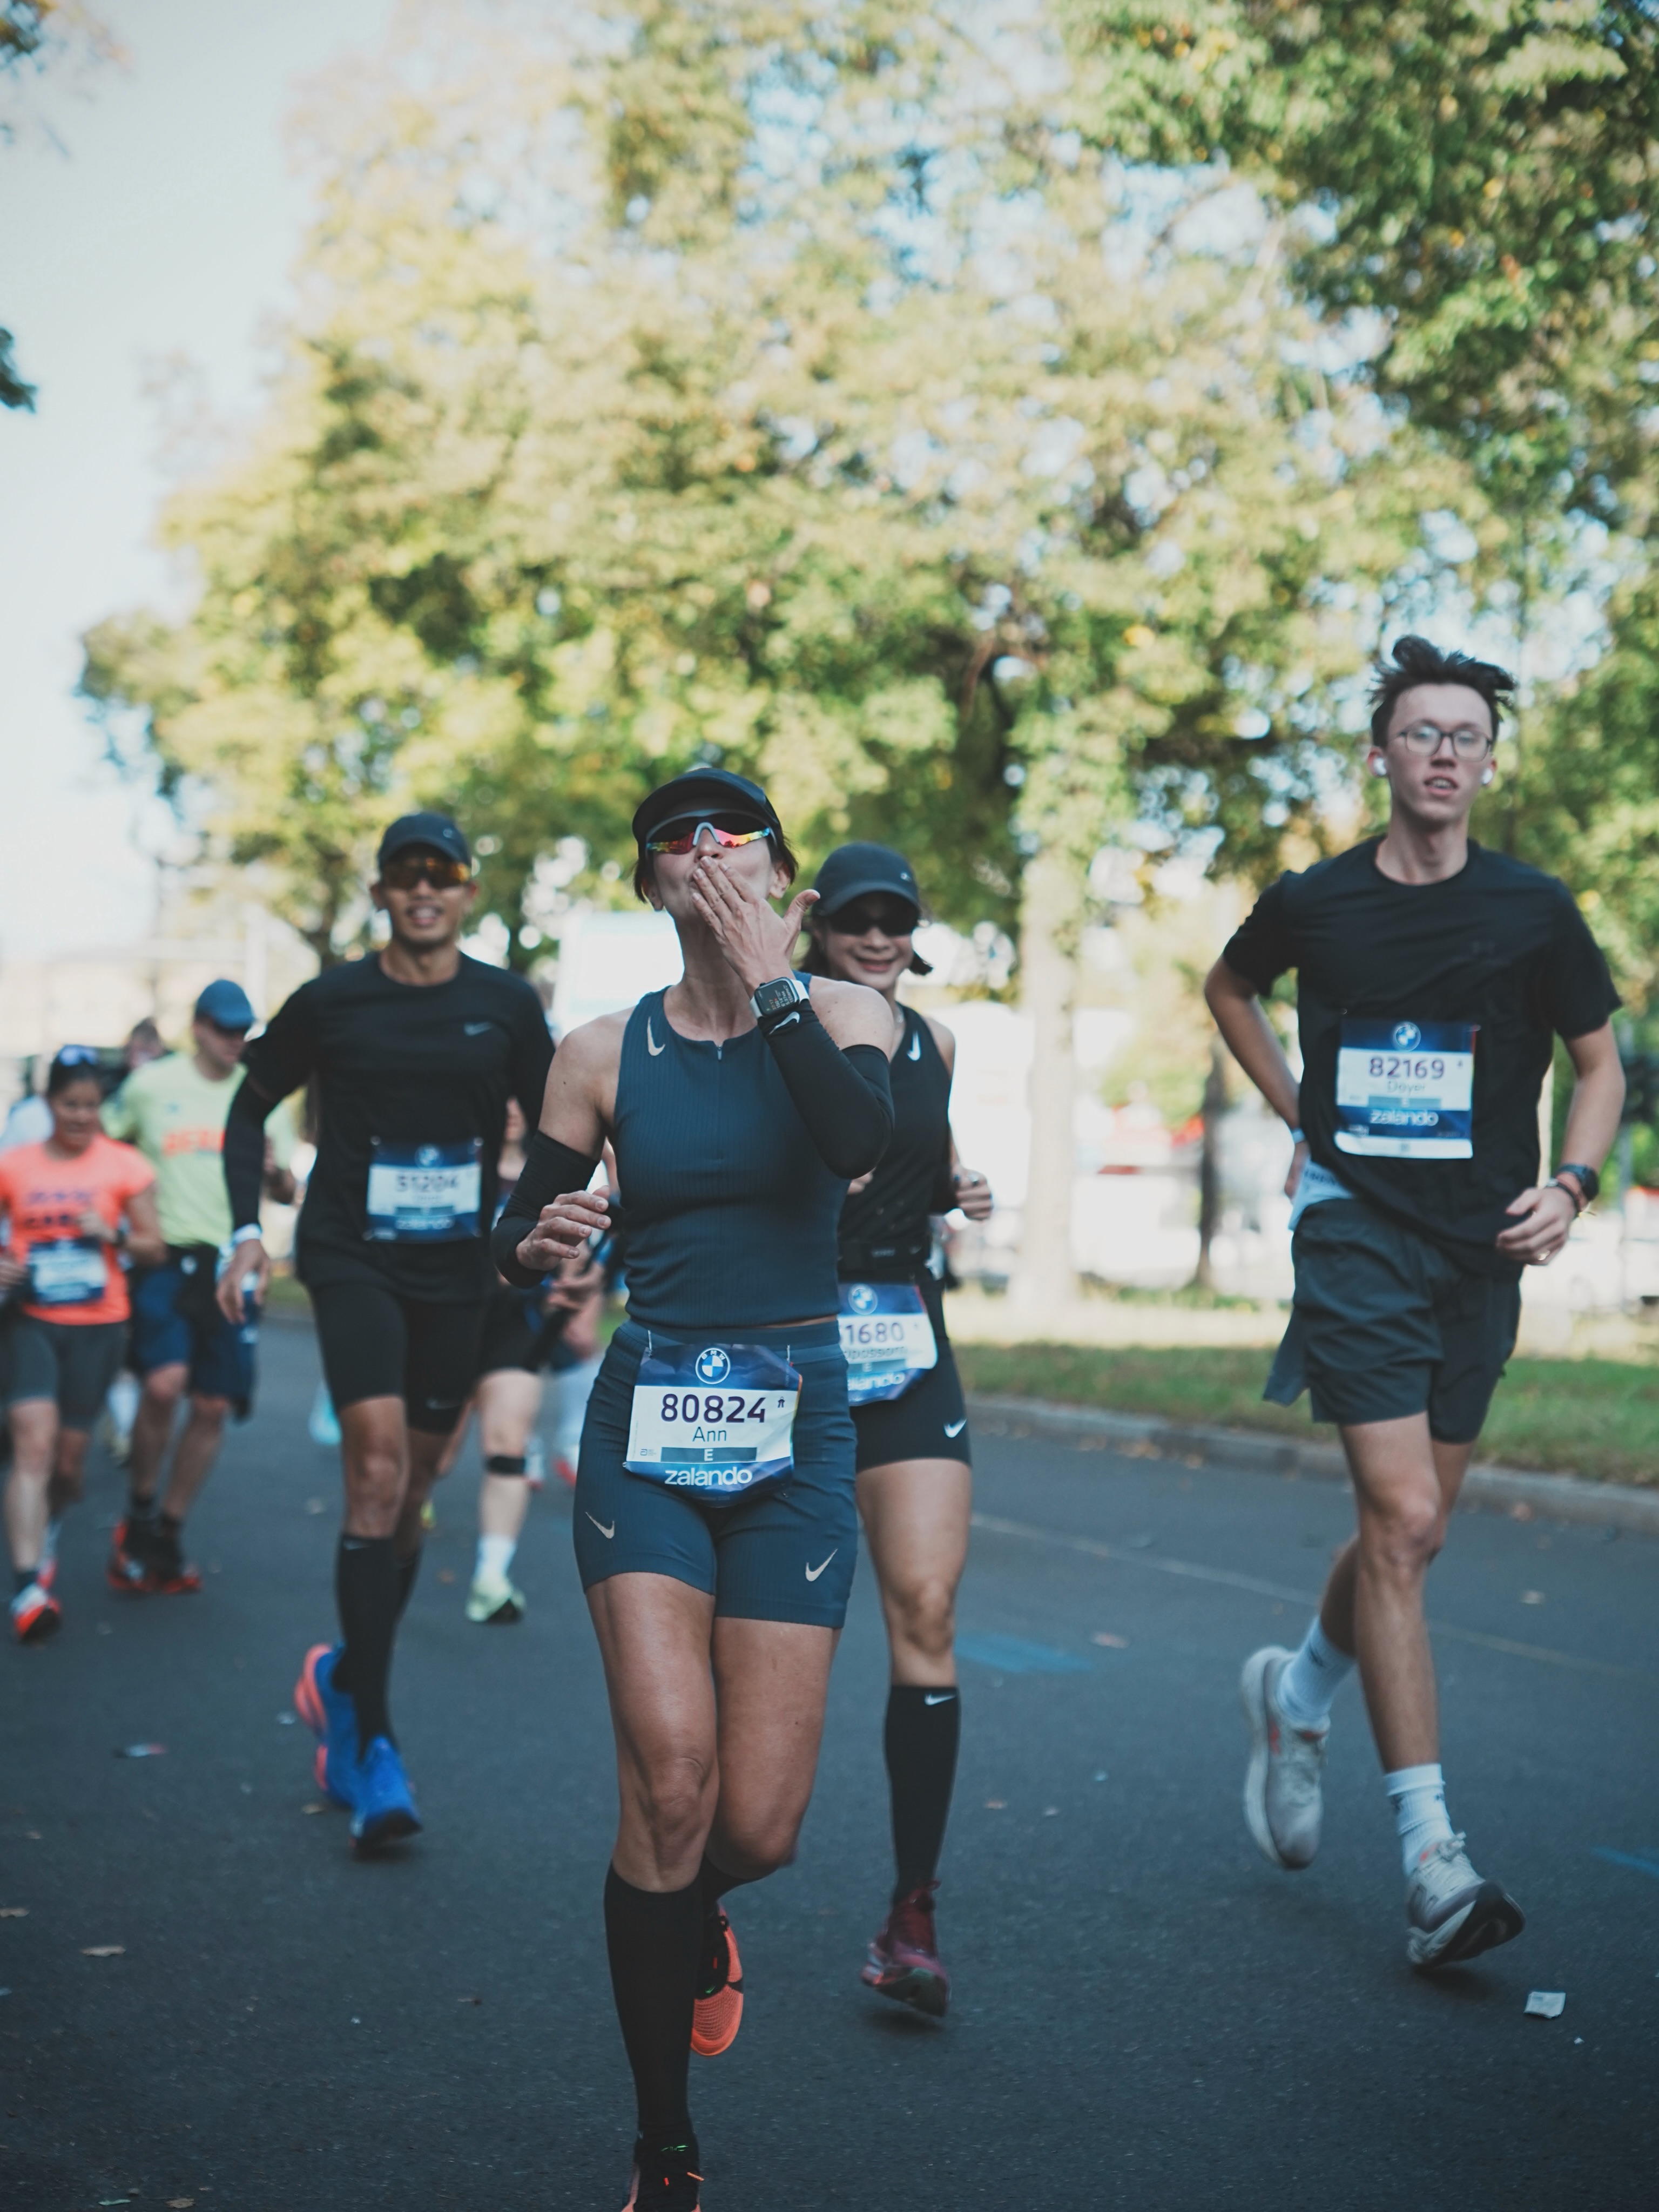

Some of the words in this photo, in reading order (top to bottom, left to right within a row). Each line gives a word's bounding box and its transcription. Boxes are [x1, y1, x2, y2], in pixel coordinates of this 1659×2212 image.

[1369, 1056, 1445, 1080] 82169
[1370, 1109, 1439, 1126] zalando
[840, 1322, 905, 1345] 1680
[701, 1350, 726, 1360] BMW
[847, 1372, 906, 1391] lando
[660, 1393, 766, 1424] 80824
[692, 1426, 727, 1442] Ann
[704, 1448, 713, 1461] E
[664, 1466, 753, 1486] zalando
